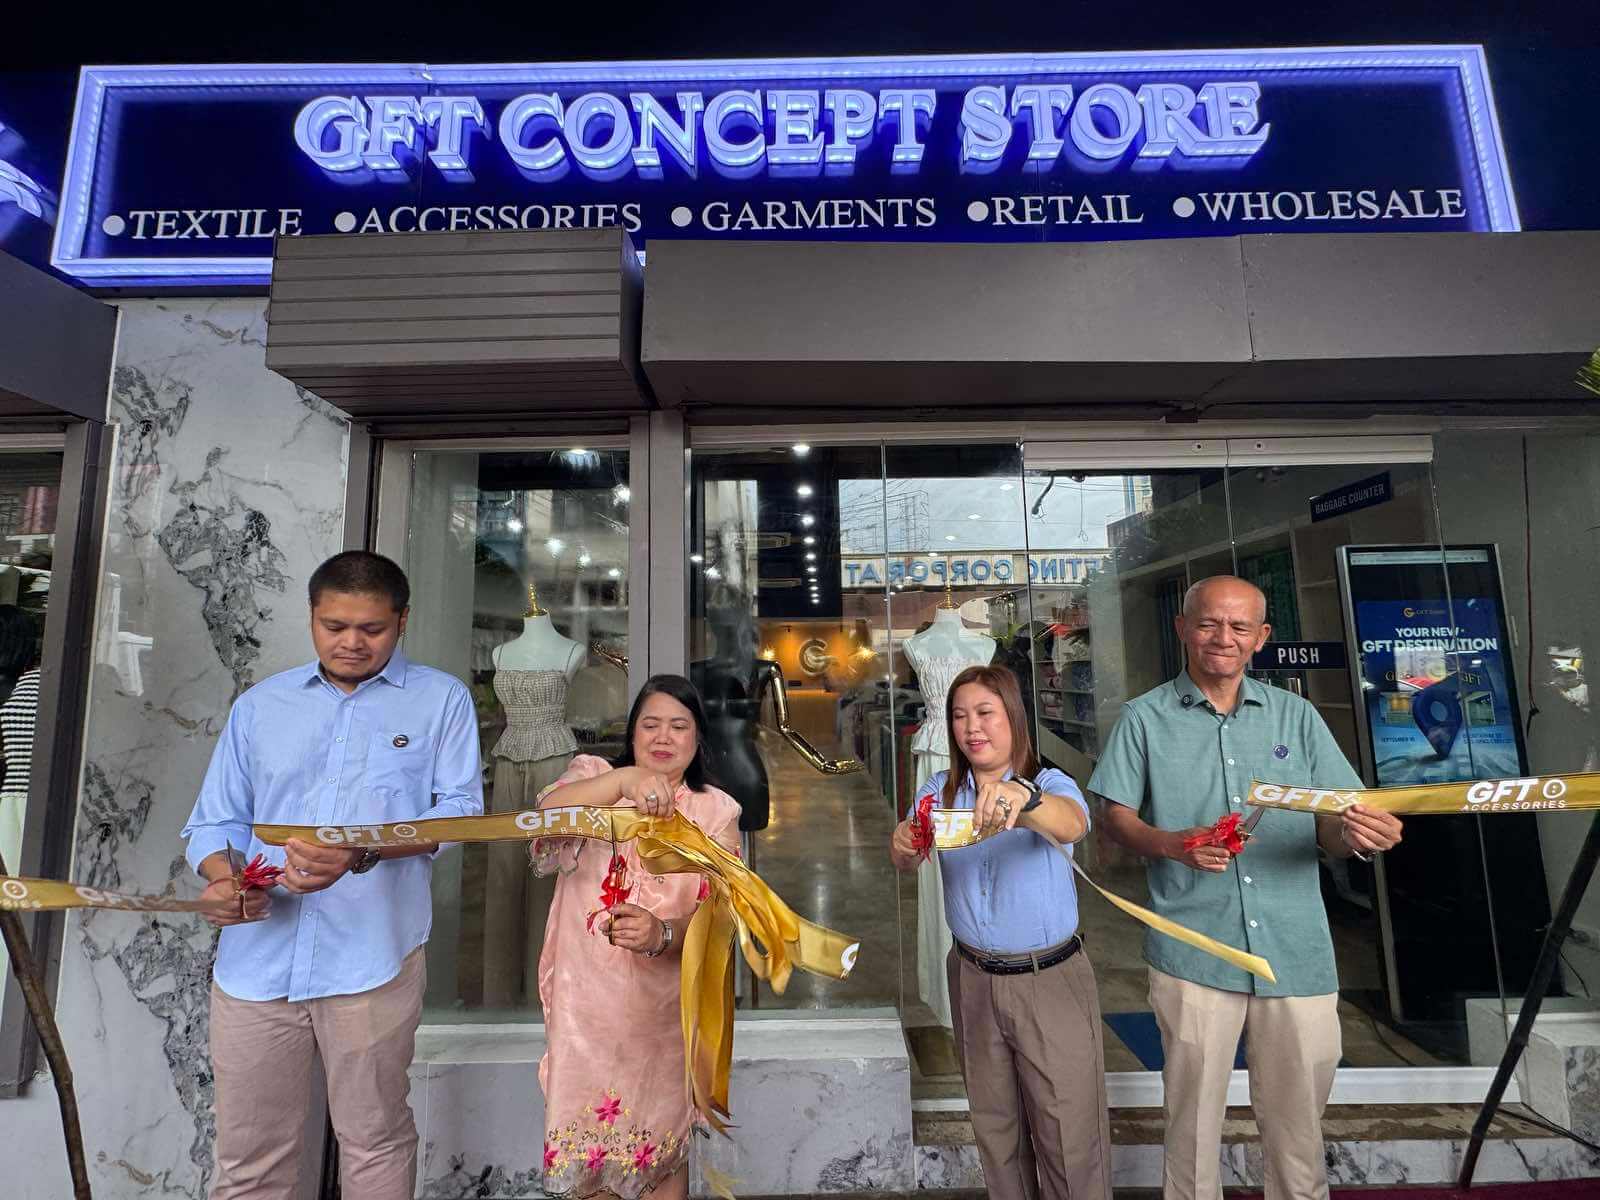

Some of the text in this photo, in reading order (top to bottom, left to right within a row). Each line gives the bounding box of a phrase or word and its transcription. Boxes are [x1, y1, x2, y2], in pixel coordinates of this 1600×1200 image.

[294, 82, 1270, 171] GFT CONCEPT STORE
[702, 198, 937, 231] GARMENTS
[991, 194, 1144, 226] RETAIL
[1198, 189, 1466, 221] WHOLESALE
[129, 209, 302, 239] TEXTILE
[358, 203, 642, 233] ACCESSORIES
[1348, 483, 1385, 504] COUNTER
[1394, 626, 1460, 638] YOUR NEW
[1277, 647, 1320, 664] PUSH
[1362, 637, 1498, 653] GFT DESTINATION
[1253, 783, 1328, 808] GFT
[1466, 778, 1539, 803] GFT
[1462, 799, 1568, 812] ACCESSORIES
[514, 806, 585, 831] GFT
[933, 811, 976, 839] GF
[316, 824, 385, 845] GFT
